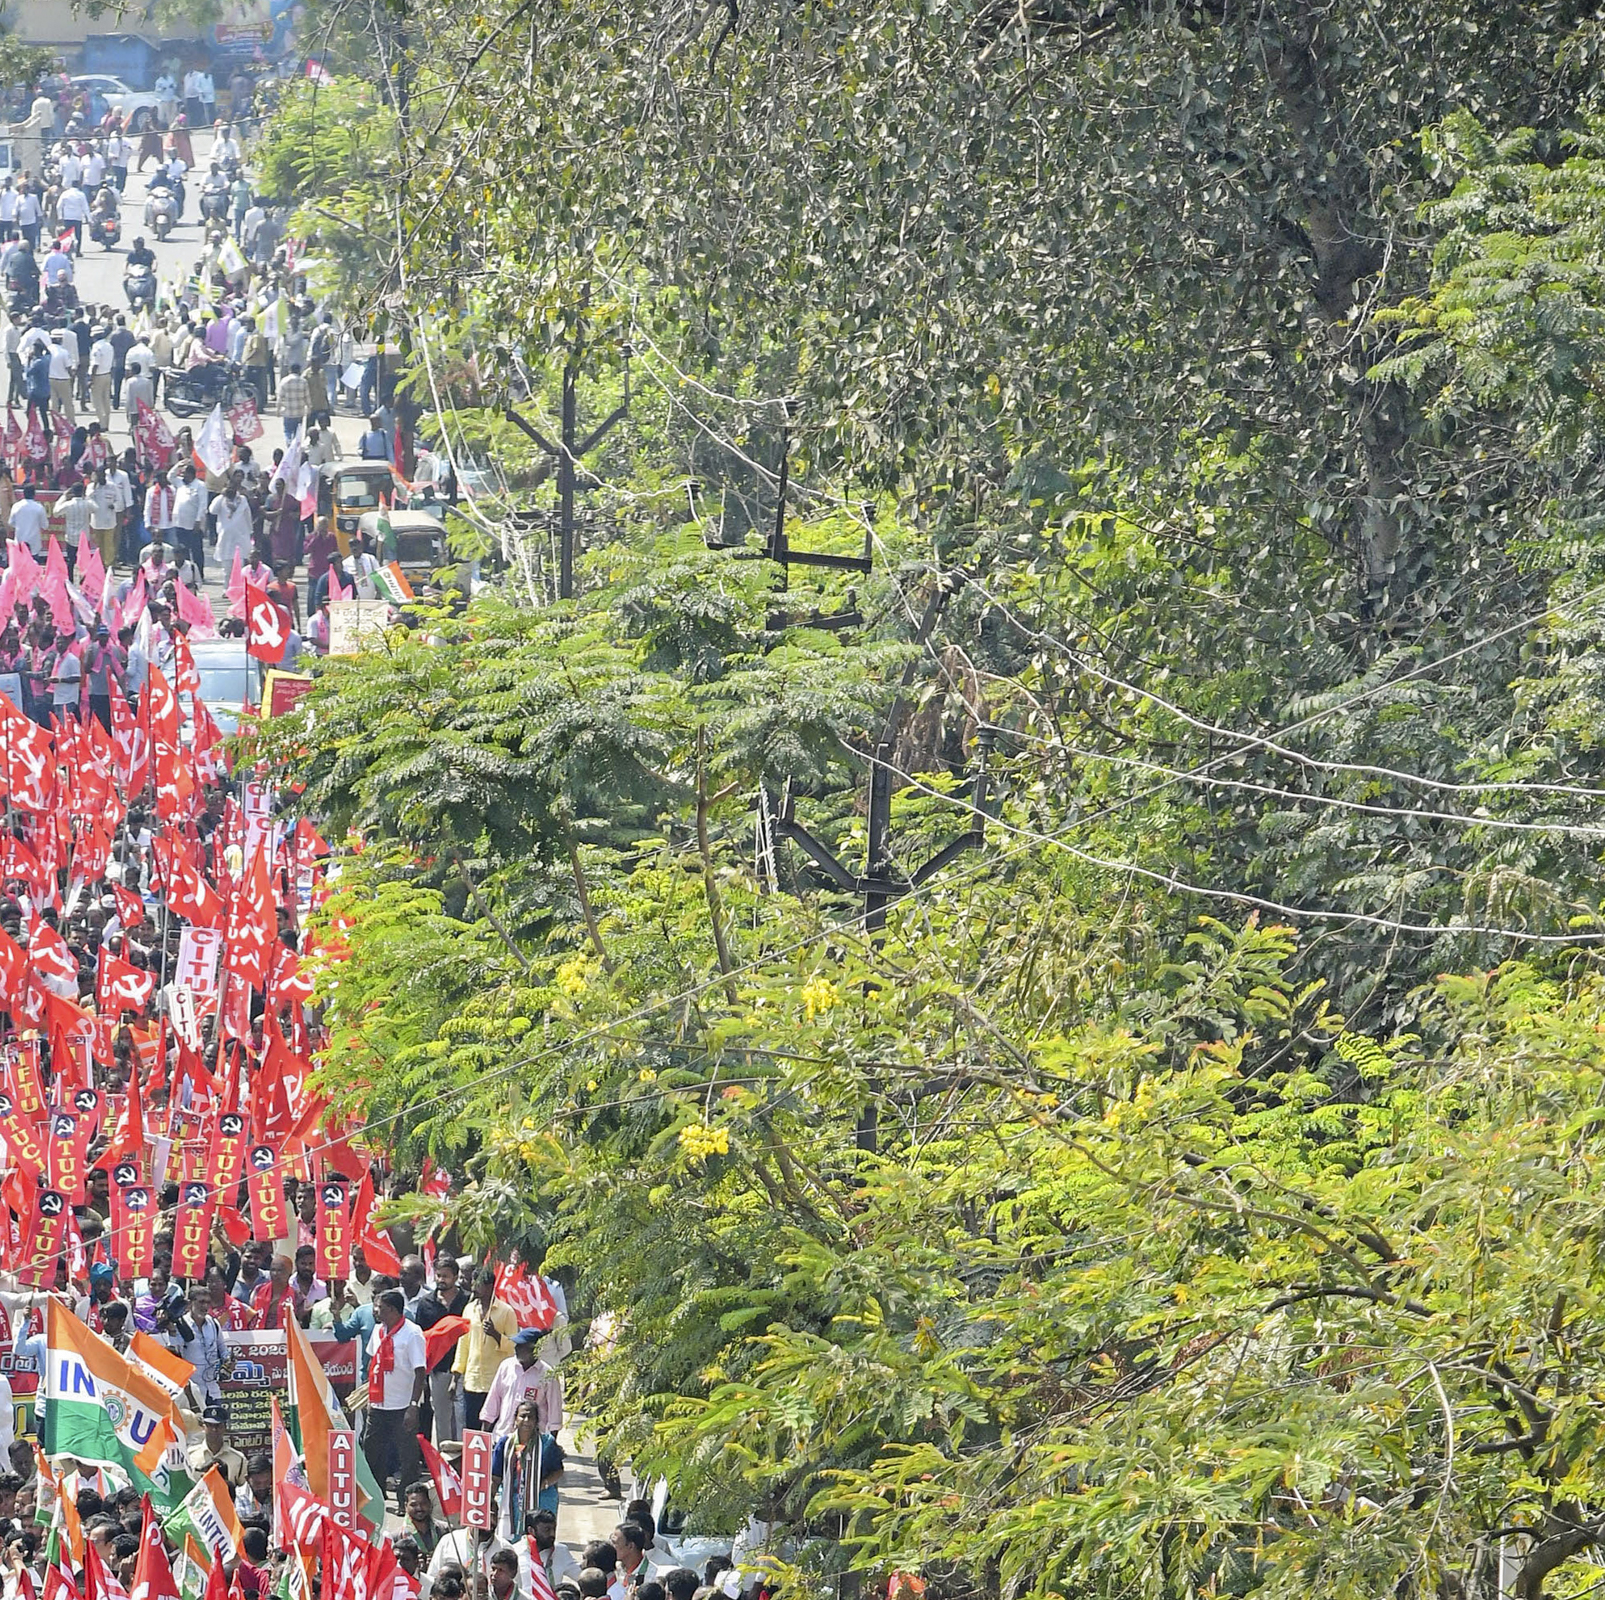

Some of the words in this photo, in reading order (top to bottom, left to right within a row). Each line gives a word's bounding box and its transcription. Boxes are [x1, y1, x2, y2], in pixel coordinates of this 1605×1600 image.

[184, 929, 216, 993] CITU
[257, 1169, 281, 1240] TUCI
[29, 1216, 58, 1287] TUCI
[125, 1211, 147, 1279] TUCI
[181, 1207, 207, 1279] TUCI
[325, 1208, 348, 1279] TUCI
[464, 1431, 493, 1528] AITUC
